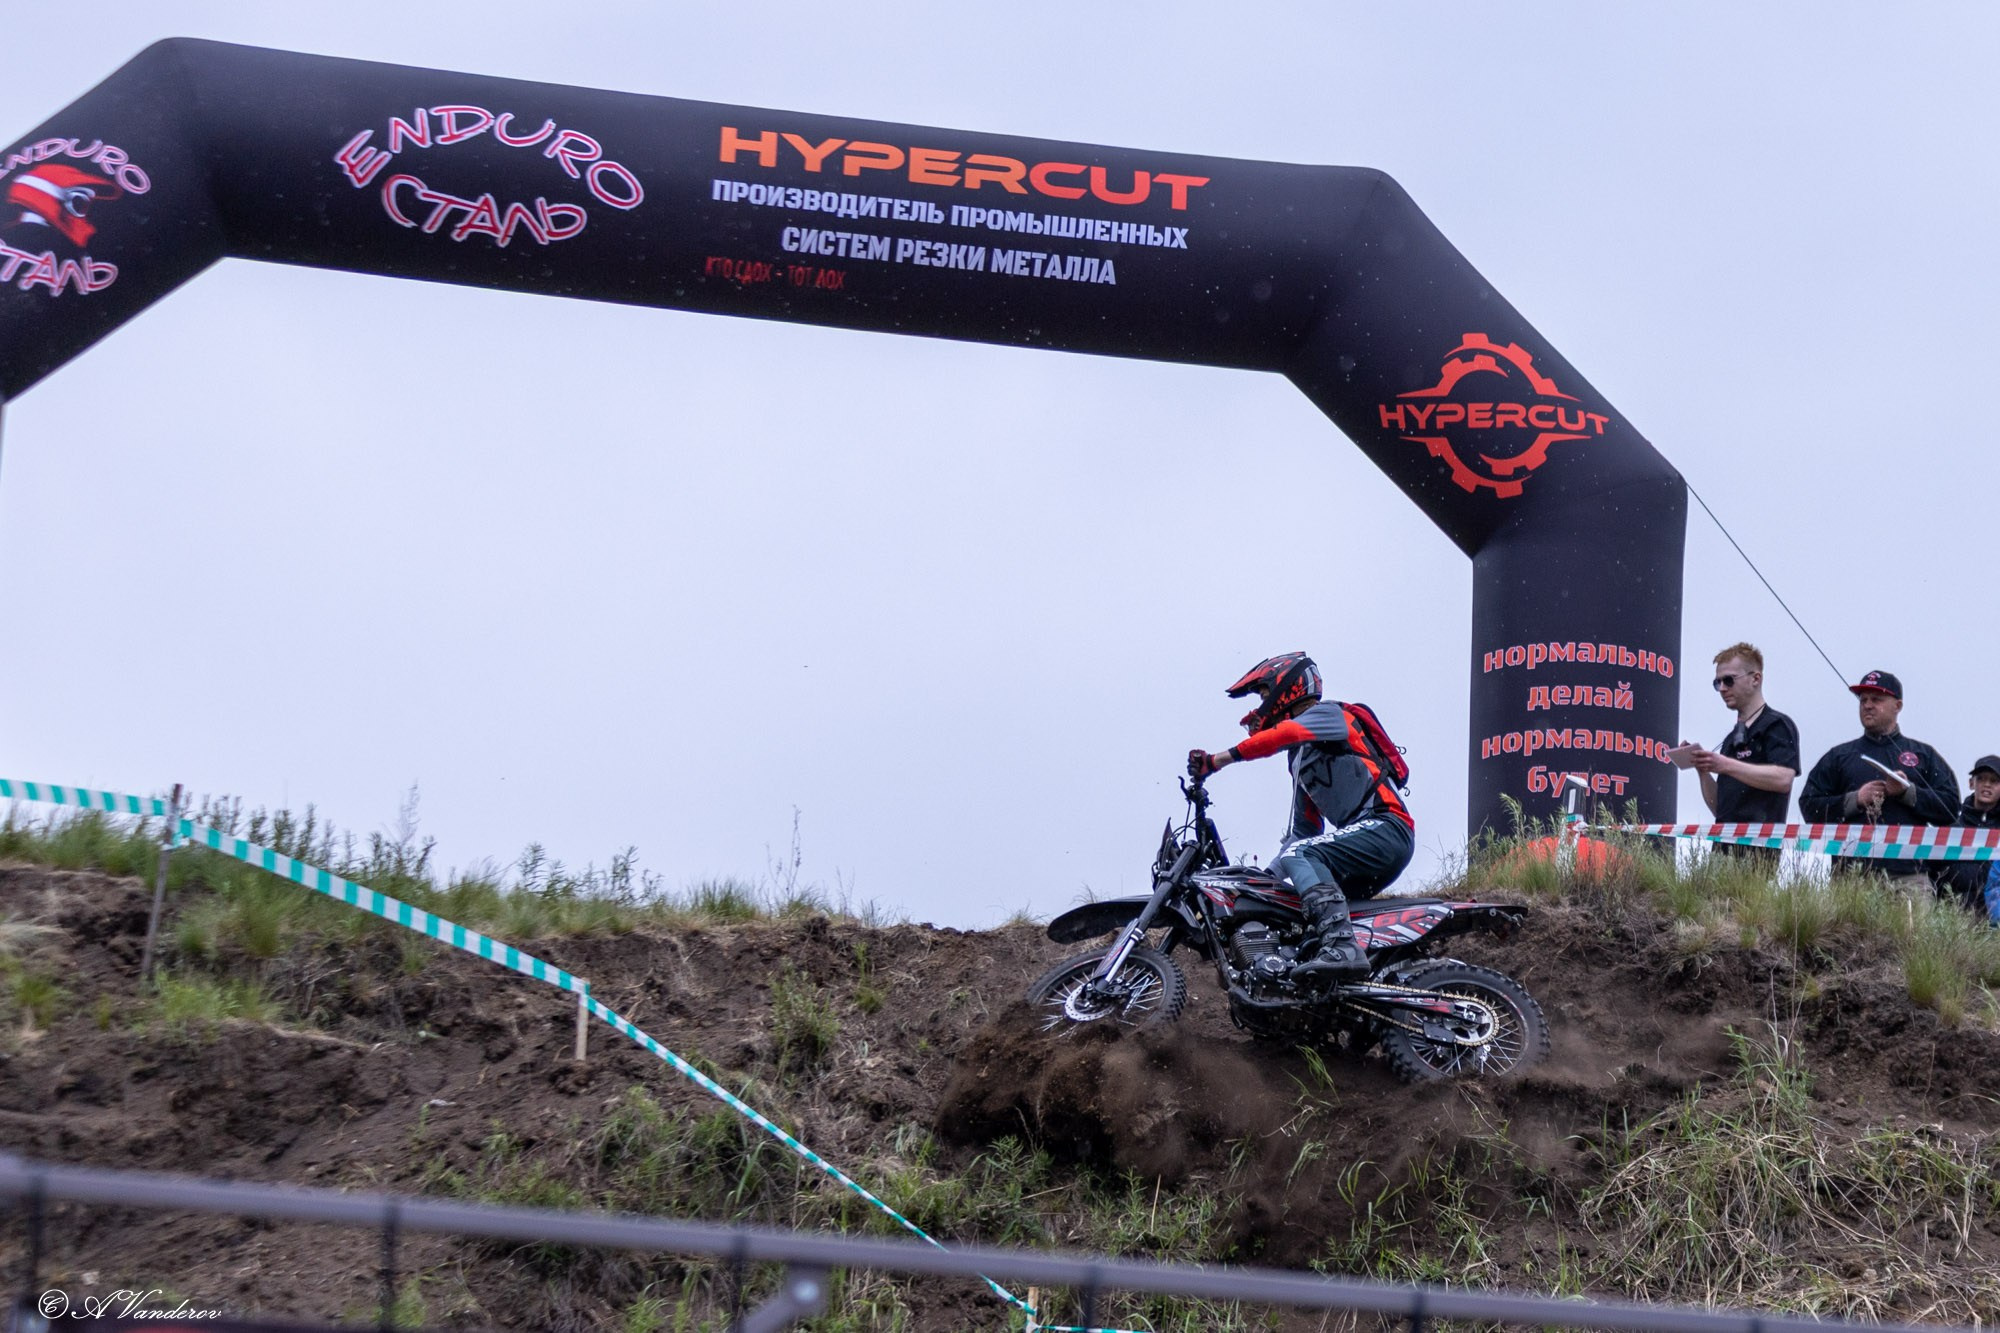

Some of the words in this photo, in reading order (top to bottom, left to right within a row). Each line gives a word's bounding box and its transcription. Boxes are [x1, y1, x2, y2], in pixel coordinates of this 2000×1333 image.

[333, 104, 645, 210] ENDURO
[719, 126, 1211, 211] HYPERCUT
[712, 178, 945, 224] ПРОИЗВОДИТЕЛЬ
[950, 205, 1190, 250] ПРОМЫШЛЕННЫХ
[781, 226, 892, 263] СИСТЕМ
[896, 238, 986, 273] РЕЗКИ
[990, 247, 1117, 286] МЕТАЛЛА
[788, 265, 813, 288] ТОТ
[815, 268, 847, 289] ЛОХ
[1378, 402, 1610, 435] HYPERCUT
[1483, 641, 1674, 679] нормально
[1527, 680, 1634, 711] делай
[1481, 728, 1672, 765] нормально
